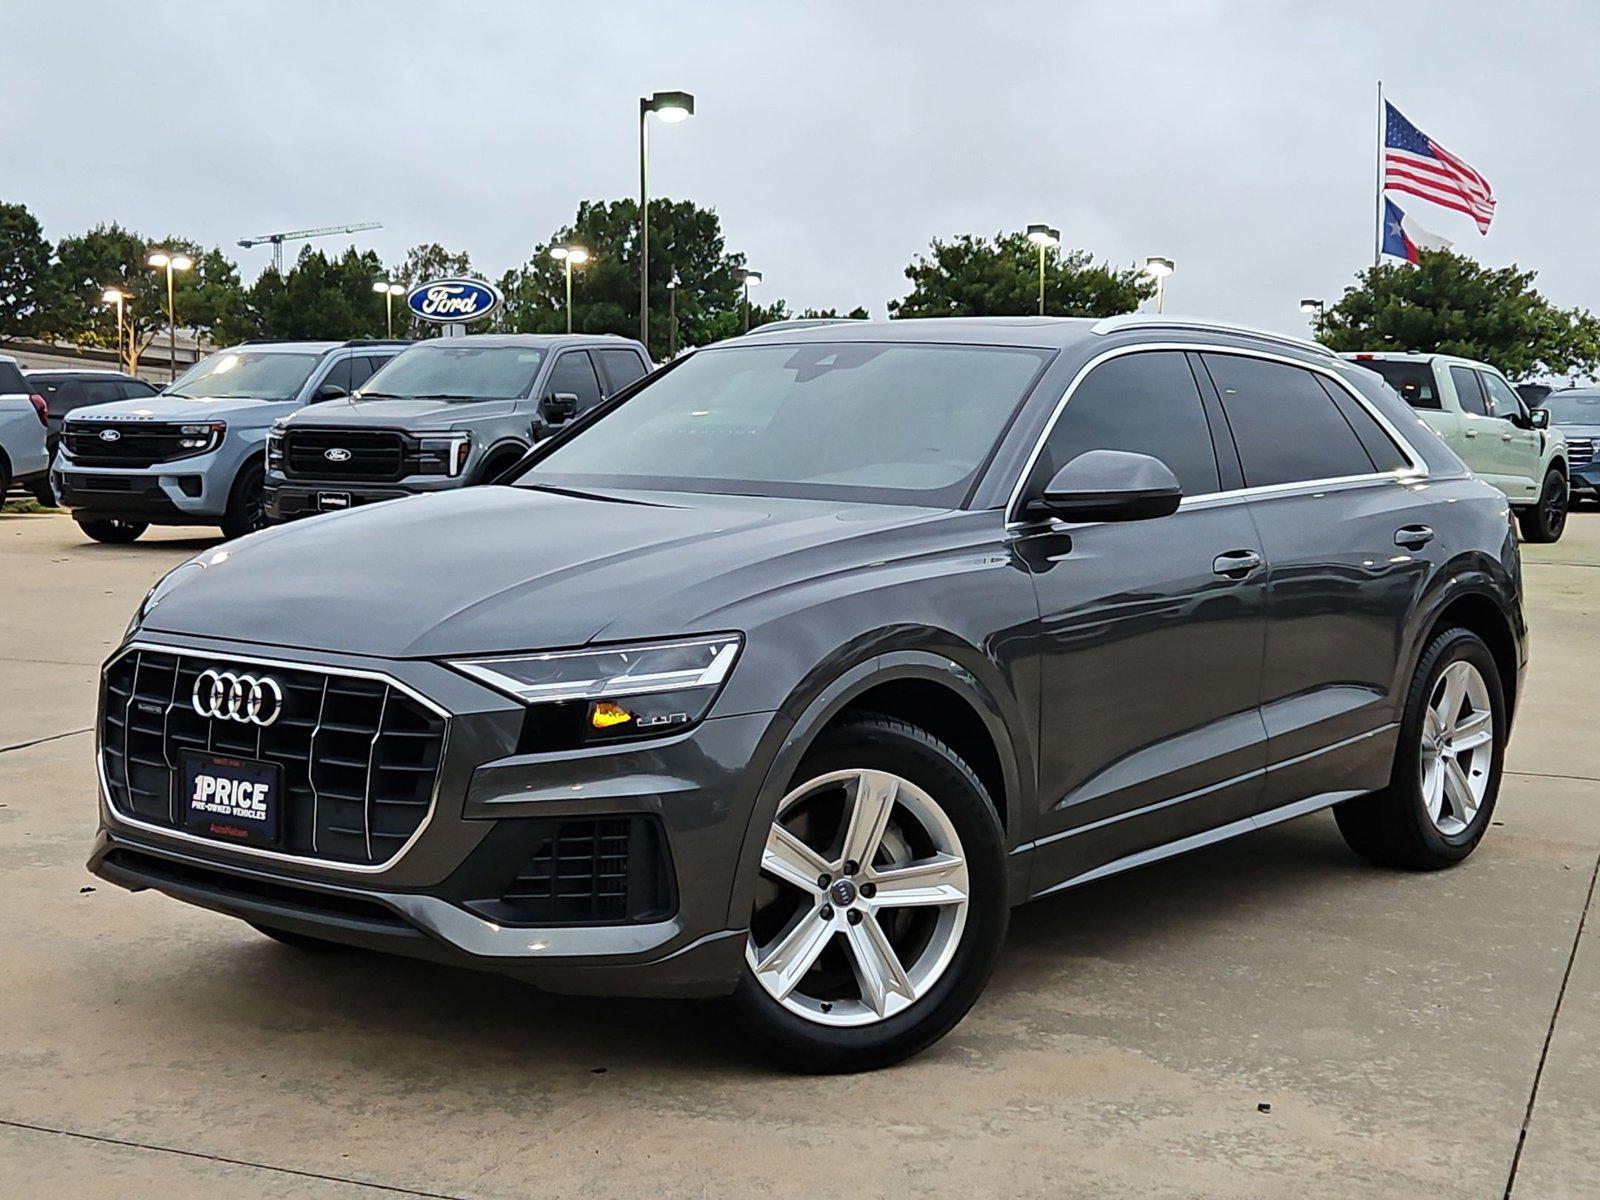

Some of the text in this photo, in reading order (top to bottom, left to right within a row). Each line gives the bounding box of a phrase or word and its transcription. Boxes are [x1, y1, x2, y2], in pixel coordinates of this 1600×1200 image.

[422, 286, 479, 313] Ford
[191, 800, 266, 821] PRE-OWNED VEHICLES
